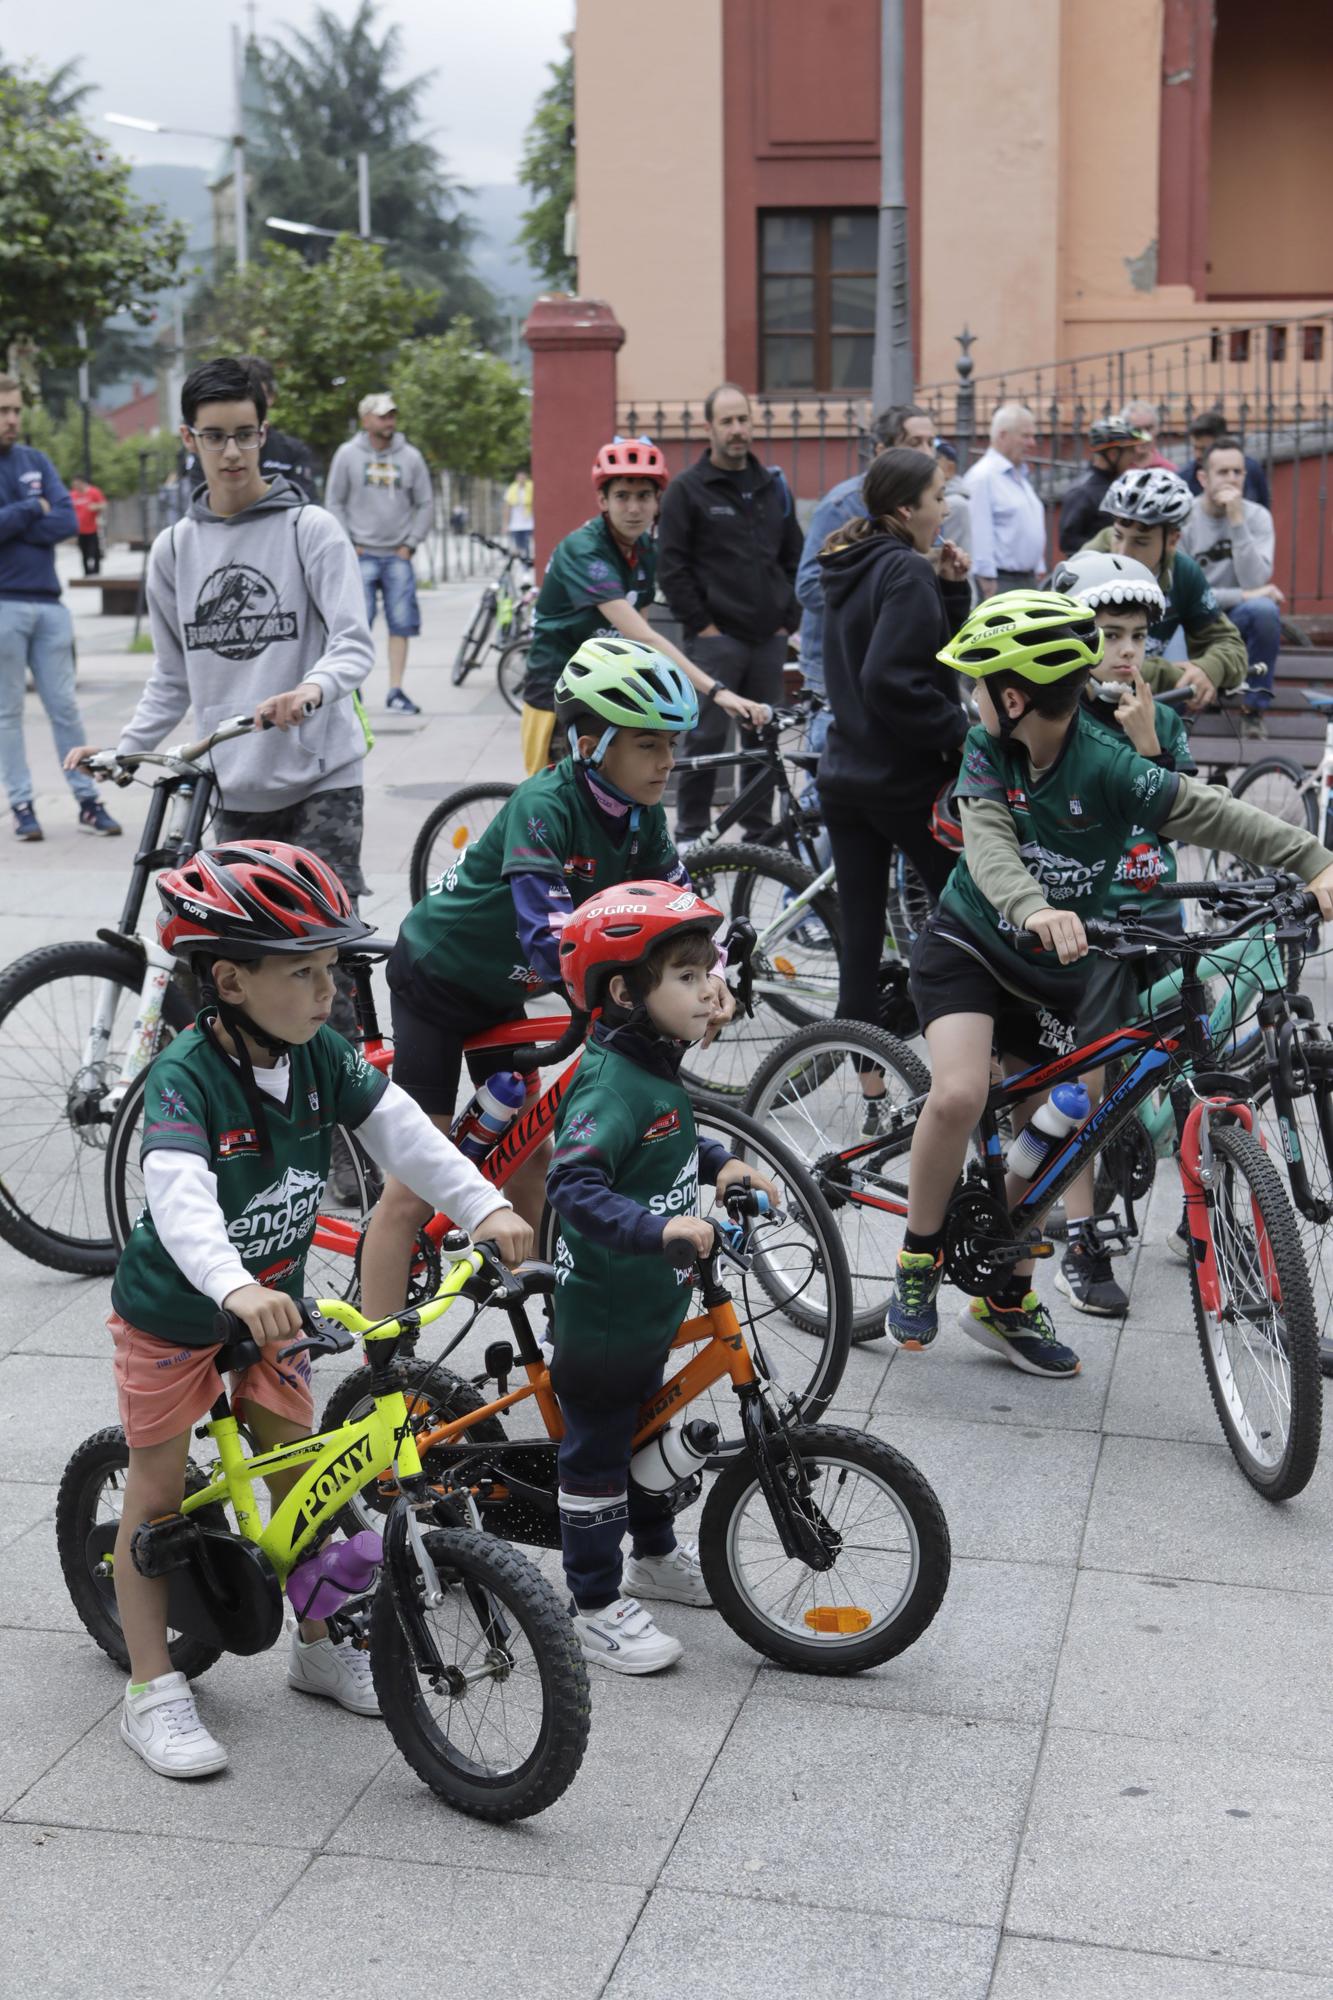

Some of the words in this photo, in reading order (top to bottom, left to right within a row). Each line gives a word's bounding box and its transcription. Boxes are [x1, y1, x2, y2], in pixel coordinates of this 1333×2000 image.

[240, 615, 296, 640] WORLD
[983, 623, 1017, 638] GIRO
[189, 904, 208, 920] DTB
[604, 904, 647, 915] GIRO
[224, 1180, 327, 1238] endero
[301, 1437, 372, 1525] PONY
